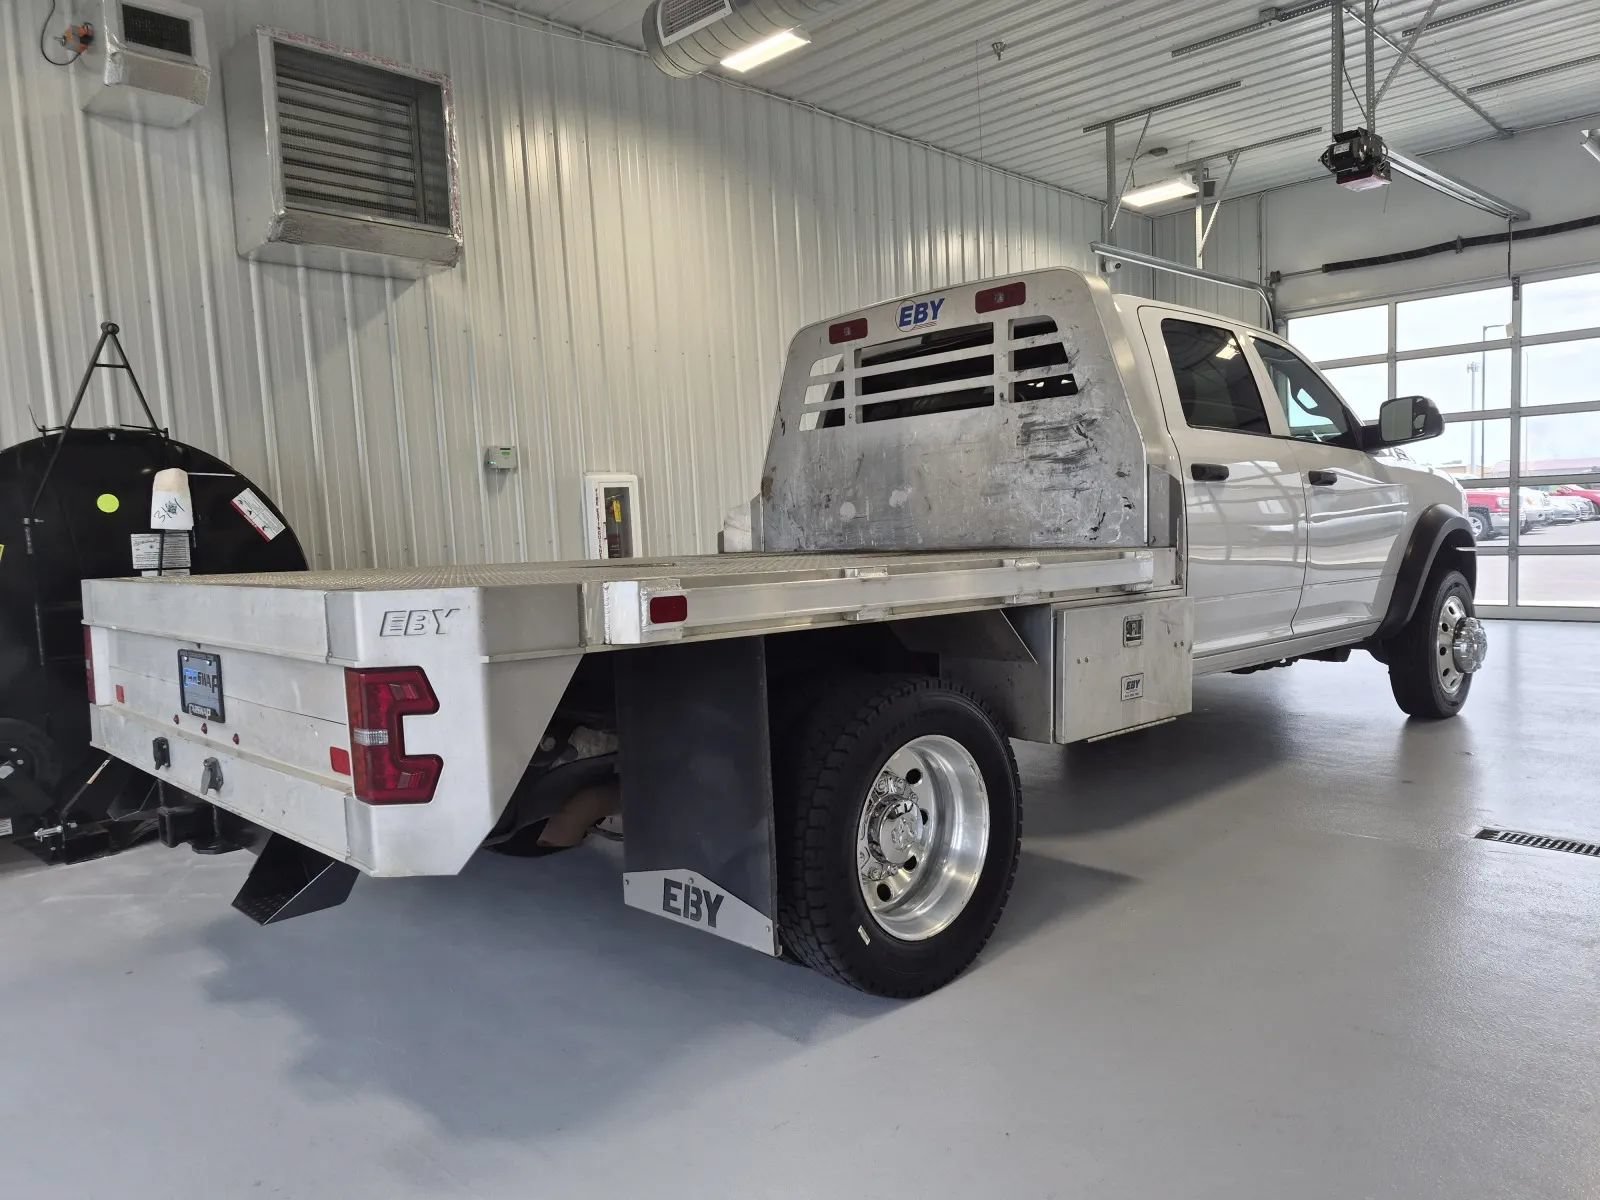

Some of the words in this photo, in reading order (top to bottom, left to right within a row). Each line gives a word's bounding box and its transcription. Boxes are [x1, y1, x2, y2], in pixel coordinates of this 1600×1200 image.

[899, 297, 945, 327] EBY
[379, 608, 461, 637] EBY
[1126, 679, 1140, 690] EBY
[663, 878, 724, 928] EBY
